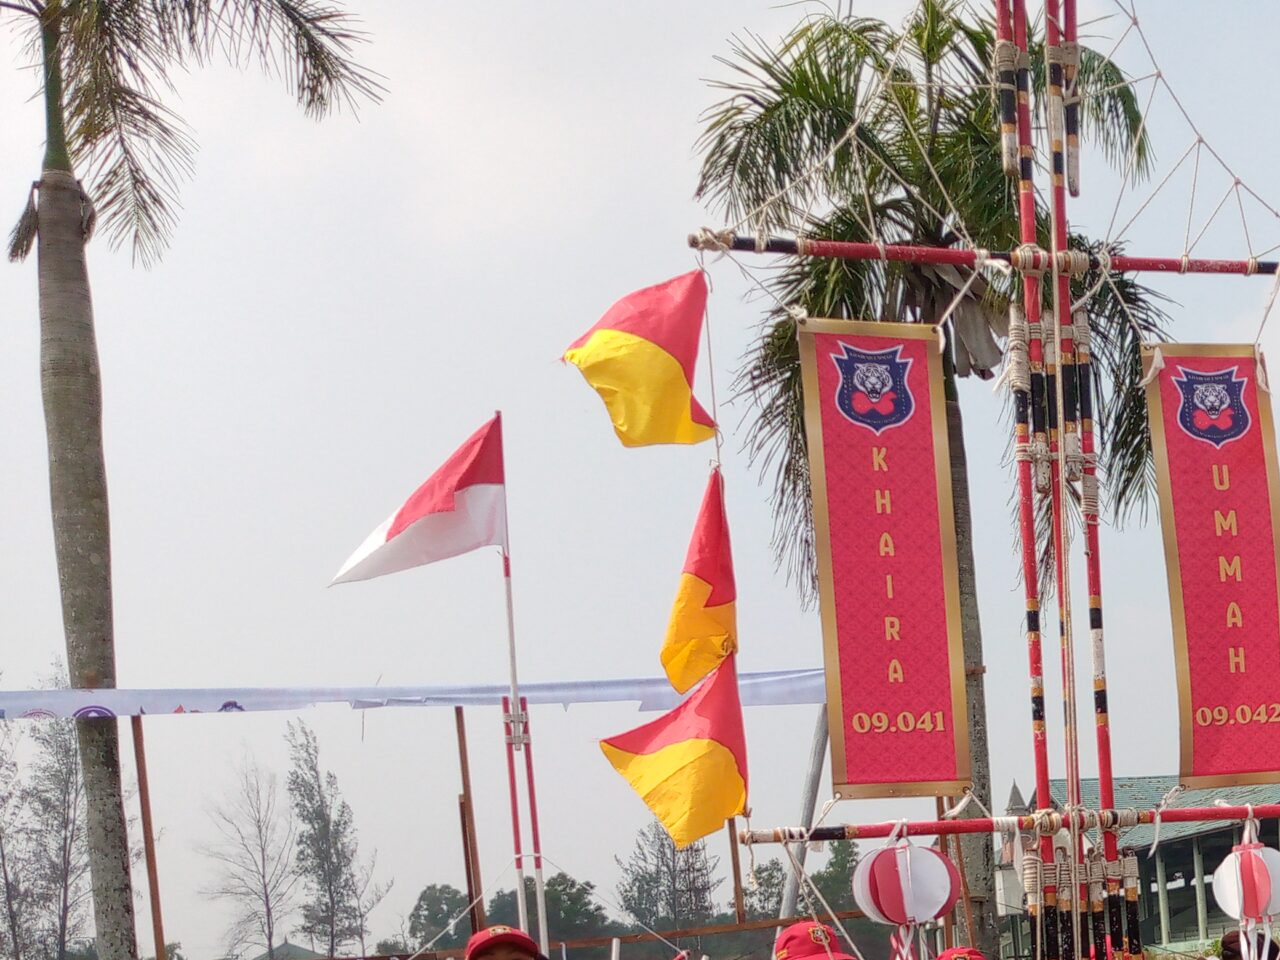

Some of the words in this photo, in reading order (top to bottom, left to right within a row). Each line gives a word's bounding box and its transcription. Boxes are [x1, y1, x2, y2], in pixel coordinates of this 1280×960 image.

[872, 446, 904, 684] KHAIRA
[1211, 464, 1246, 674] UMMAH
[851, 710, 946, 734] 09.041
